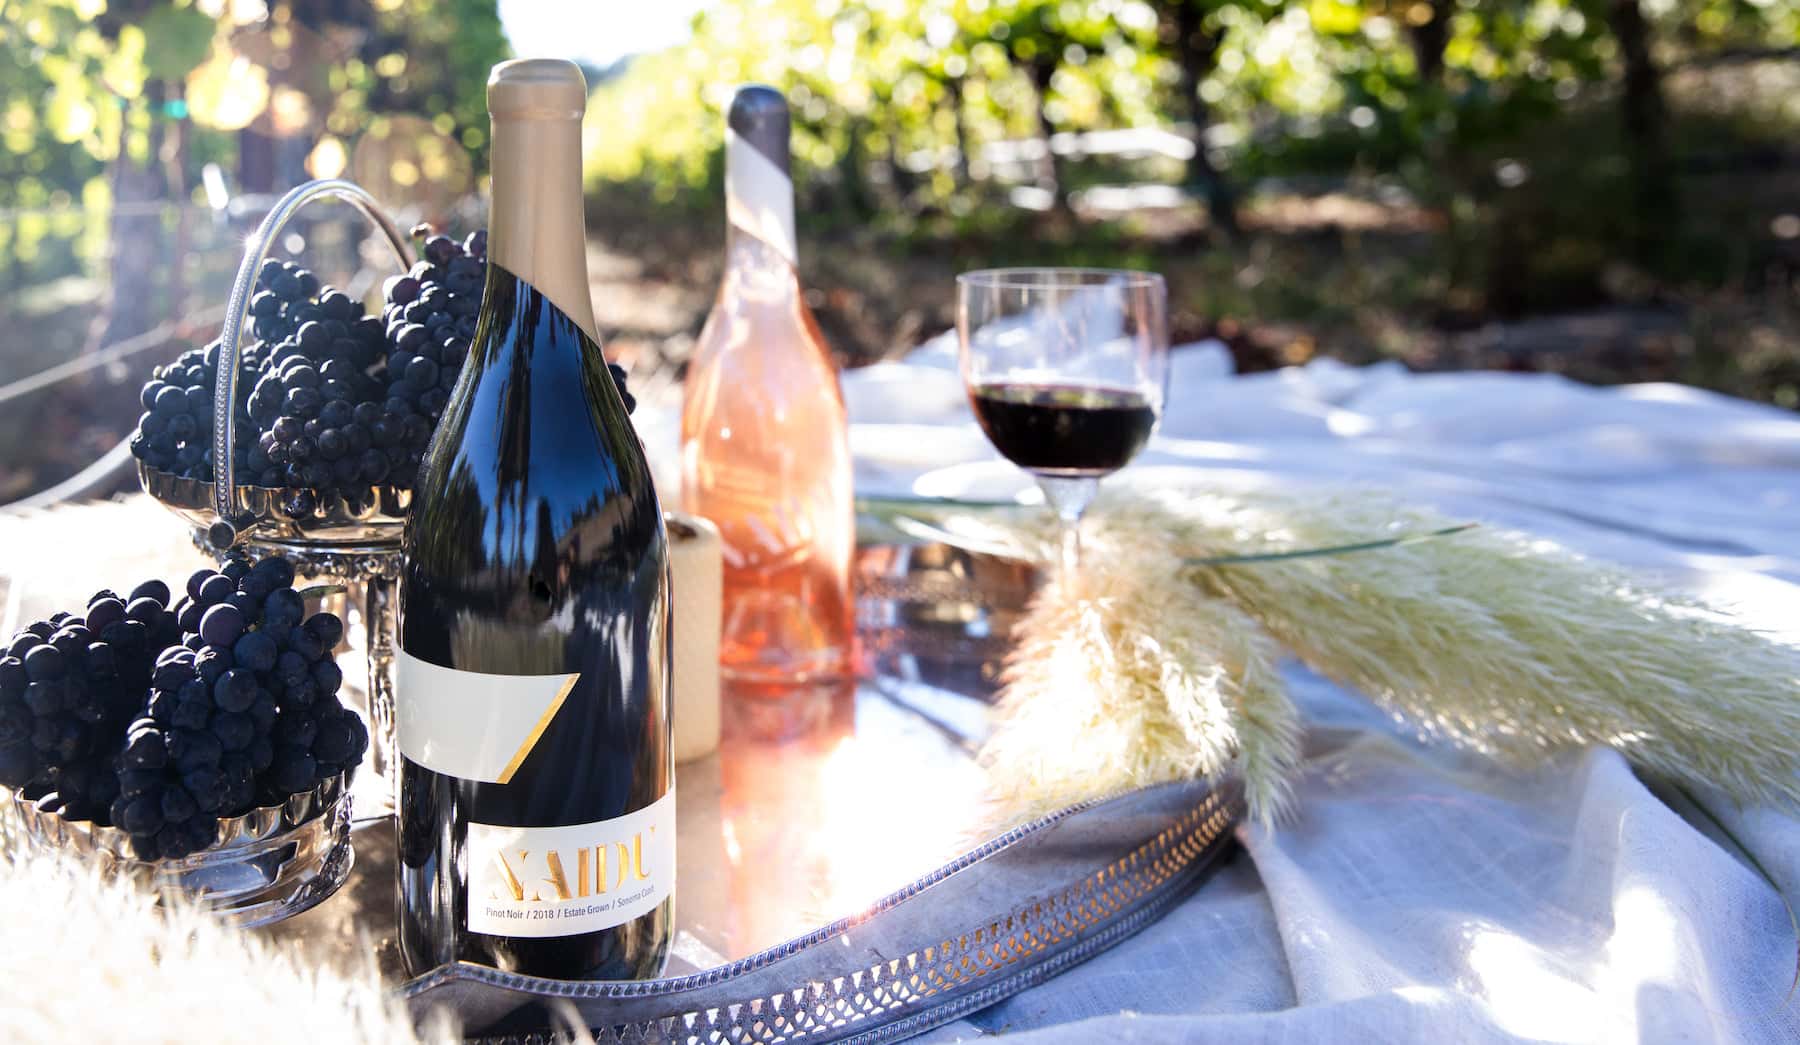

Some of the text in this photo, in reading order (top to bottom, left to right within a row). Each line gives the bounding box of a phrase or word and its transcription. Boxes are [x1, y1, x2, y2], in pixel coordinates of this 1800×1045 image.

[488, 826, 656, 901] NAIDU
[486, 907, 506, 919] Pinot
[507, 909, 524, 920] Noir
[533, 909, 554, 920] 2018
[564, 907, 586, 918] Estate
[587, 903, 610, 915] Grown
[617, 892, 641, 908] Sonoma
